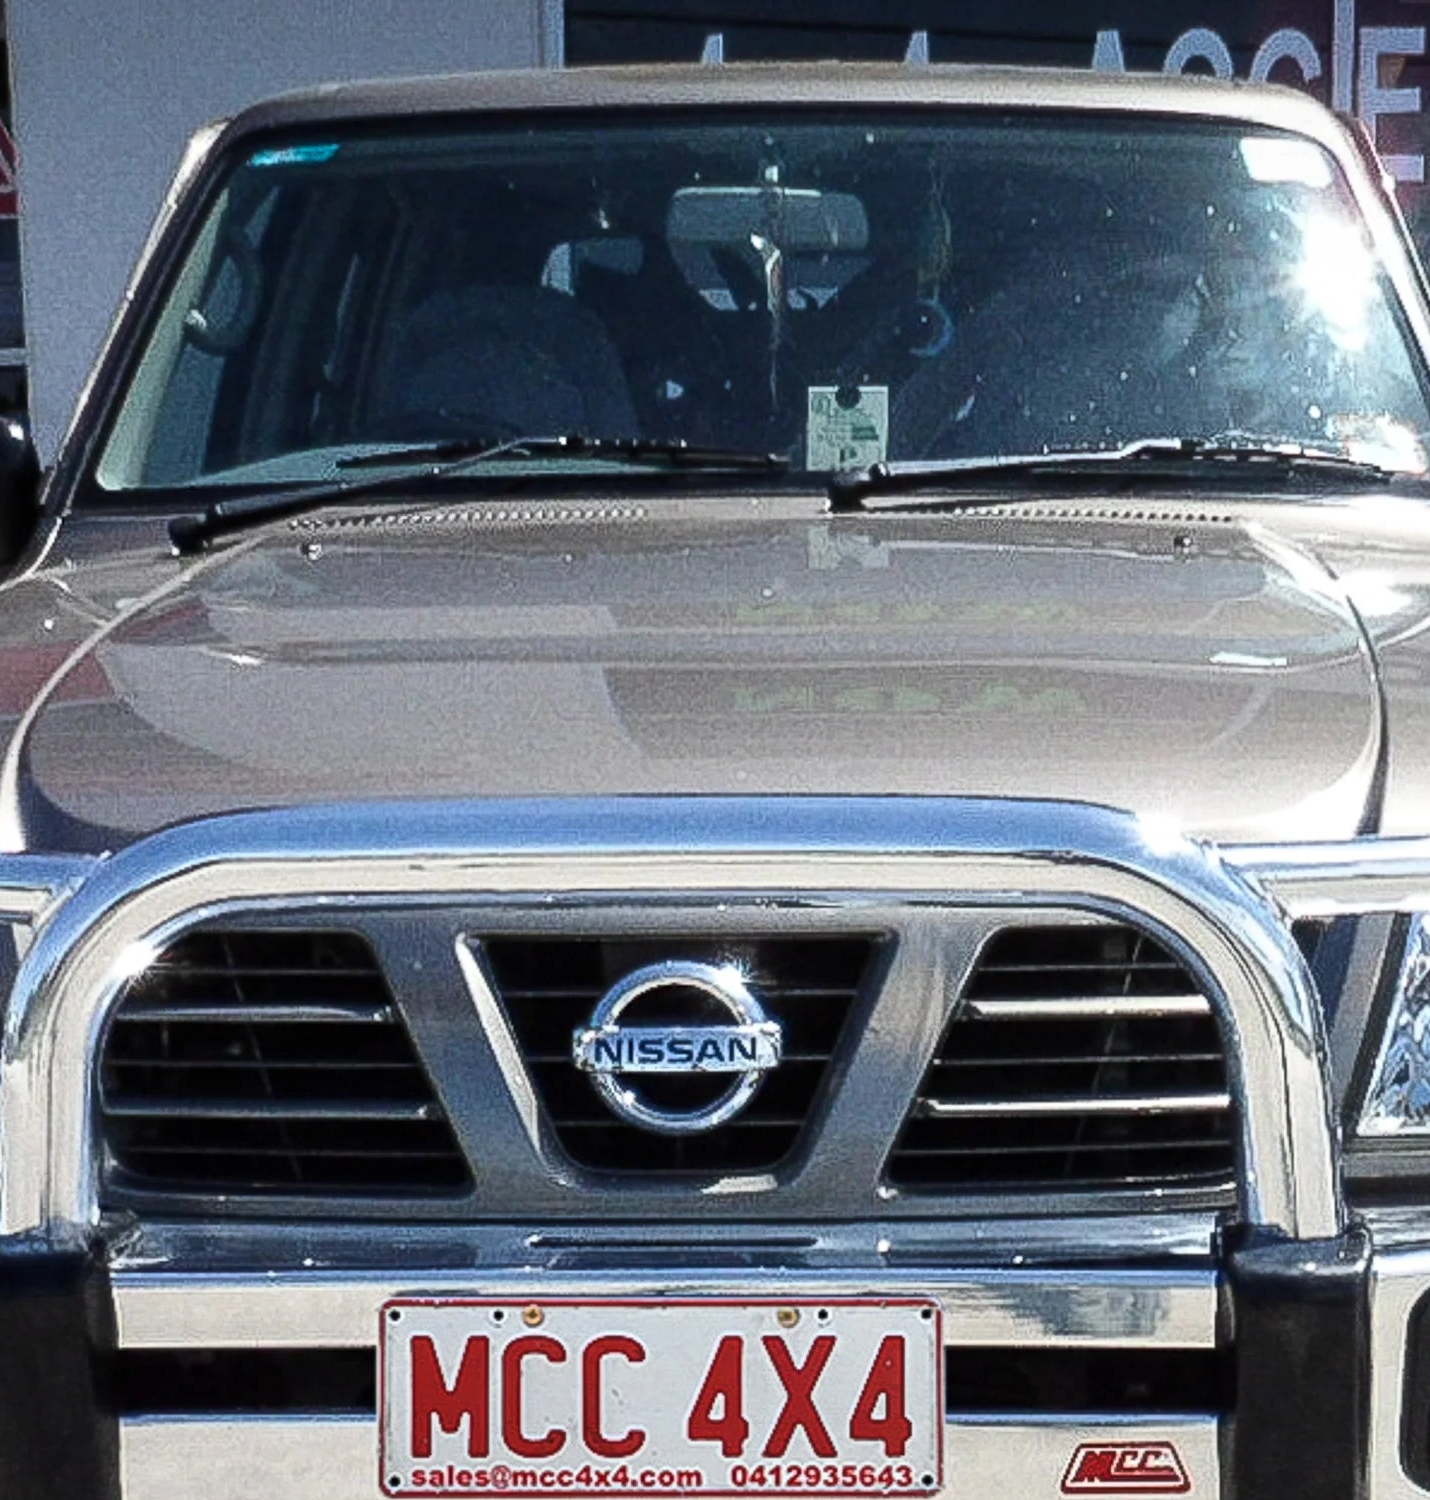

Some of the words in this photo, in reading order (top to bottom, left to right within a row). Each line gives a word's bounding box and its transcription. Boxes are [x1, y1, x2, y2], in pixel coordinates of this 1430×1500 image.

[593, 1036, 757, 1065] NISSAN
[410, 1335, 647, 1459] MCC
[687, 1335, 913, 1459] 4X4
[411, 1465, 703, 1489] sales@mcc4x4.com
[730, 1464, 913, 1487] 0412935643
[1071, 1450, 1174, 1482] MCC
